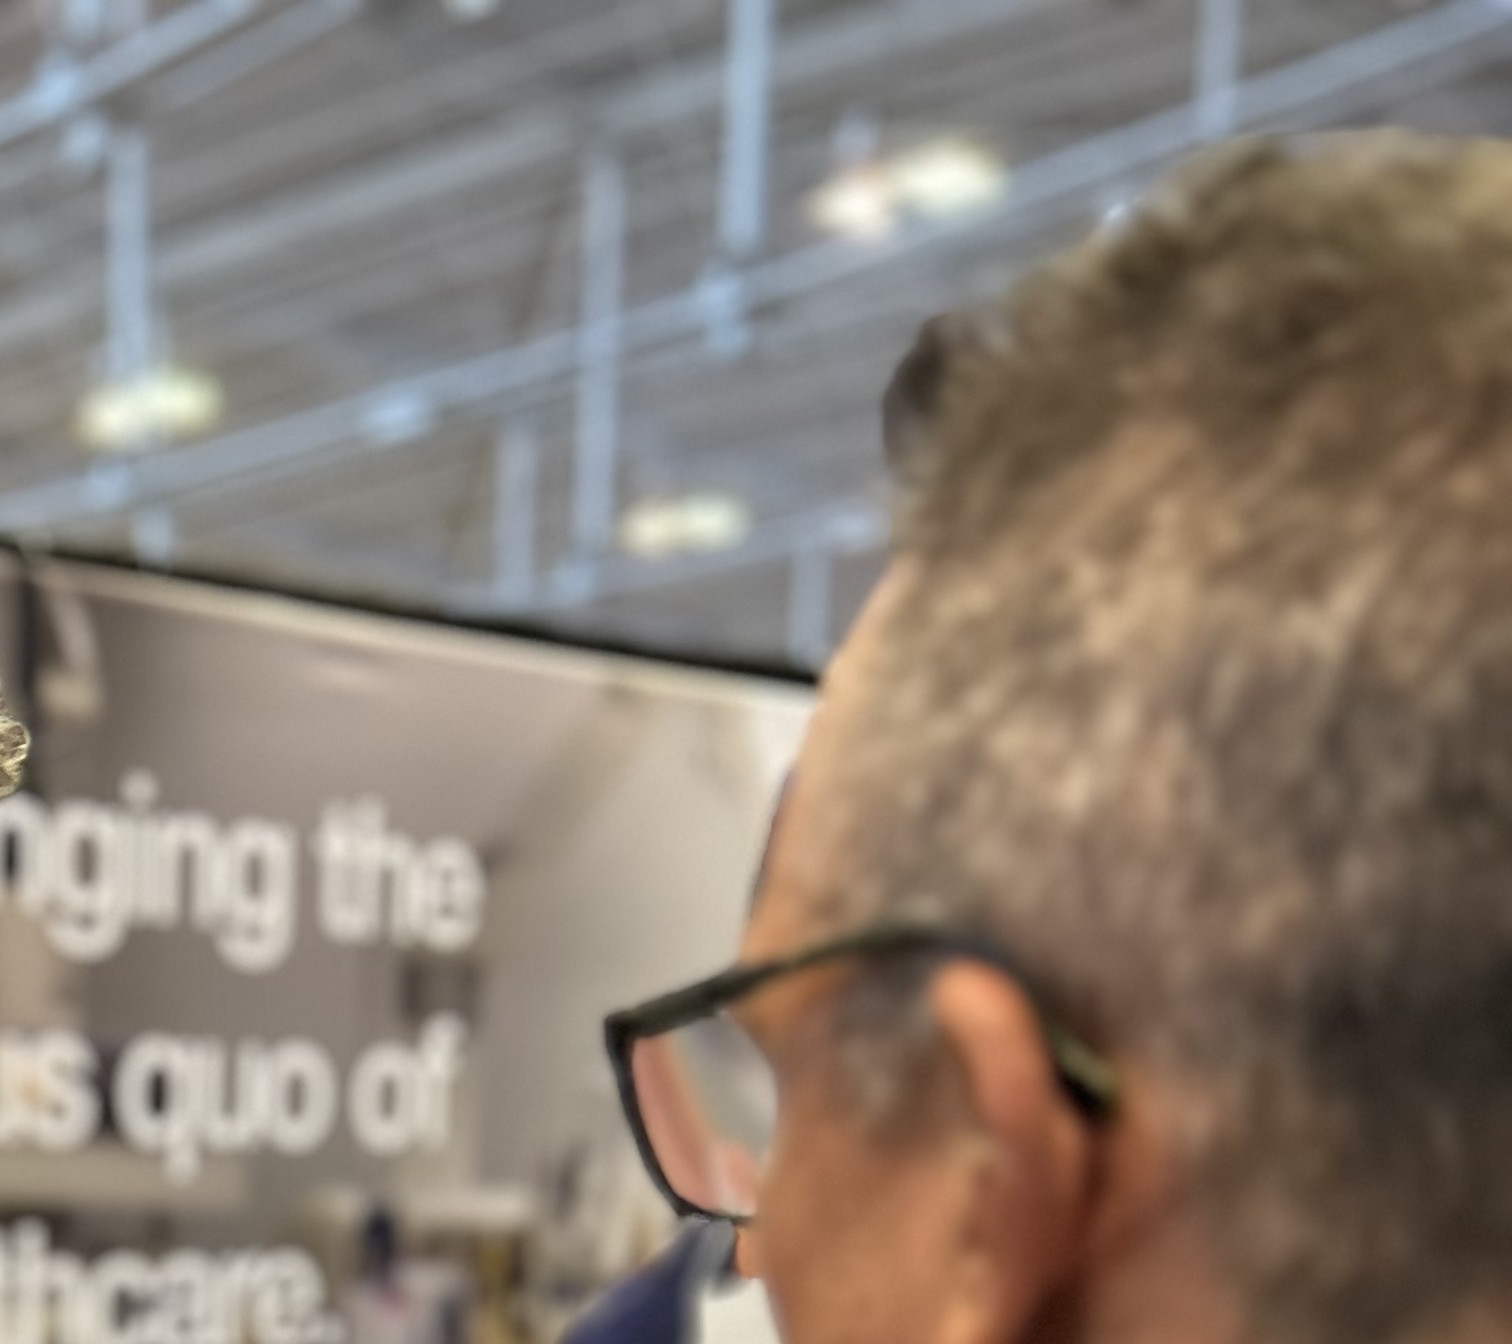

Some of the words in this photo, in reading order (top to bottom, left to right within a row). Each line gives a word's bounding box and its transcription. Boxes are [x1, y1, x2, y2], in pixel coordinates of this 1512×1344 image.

[316, 797, 487, 952] the
[112, 1033, 337, 1186] quo
[345, 1012, 465, 1156] of
